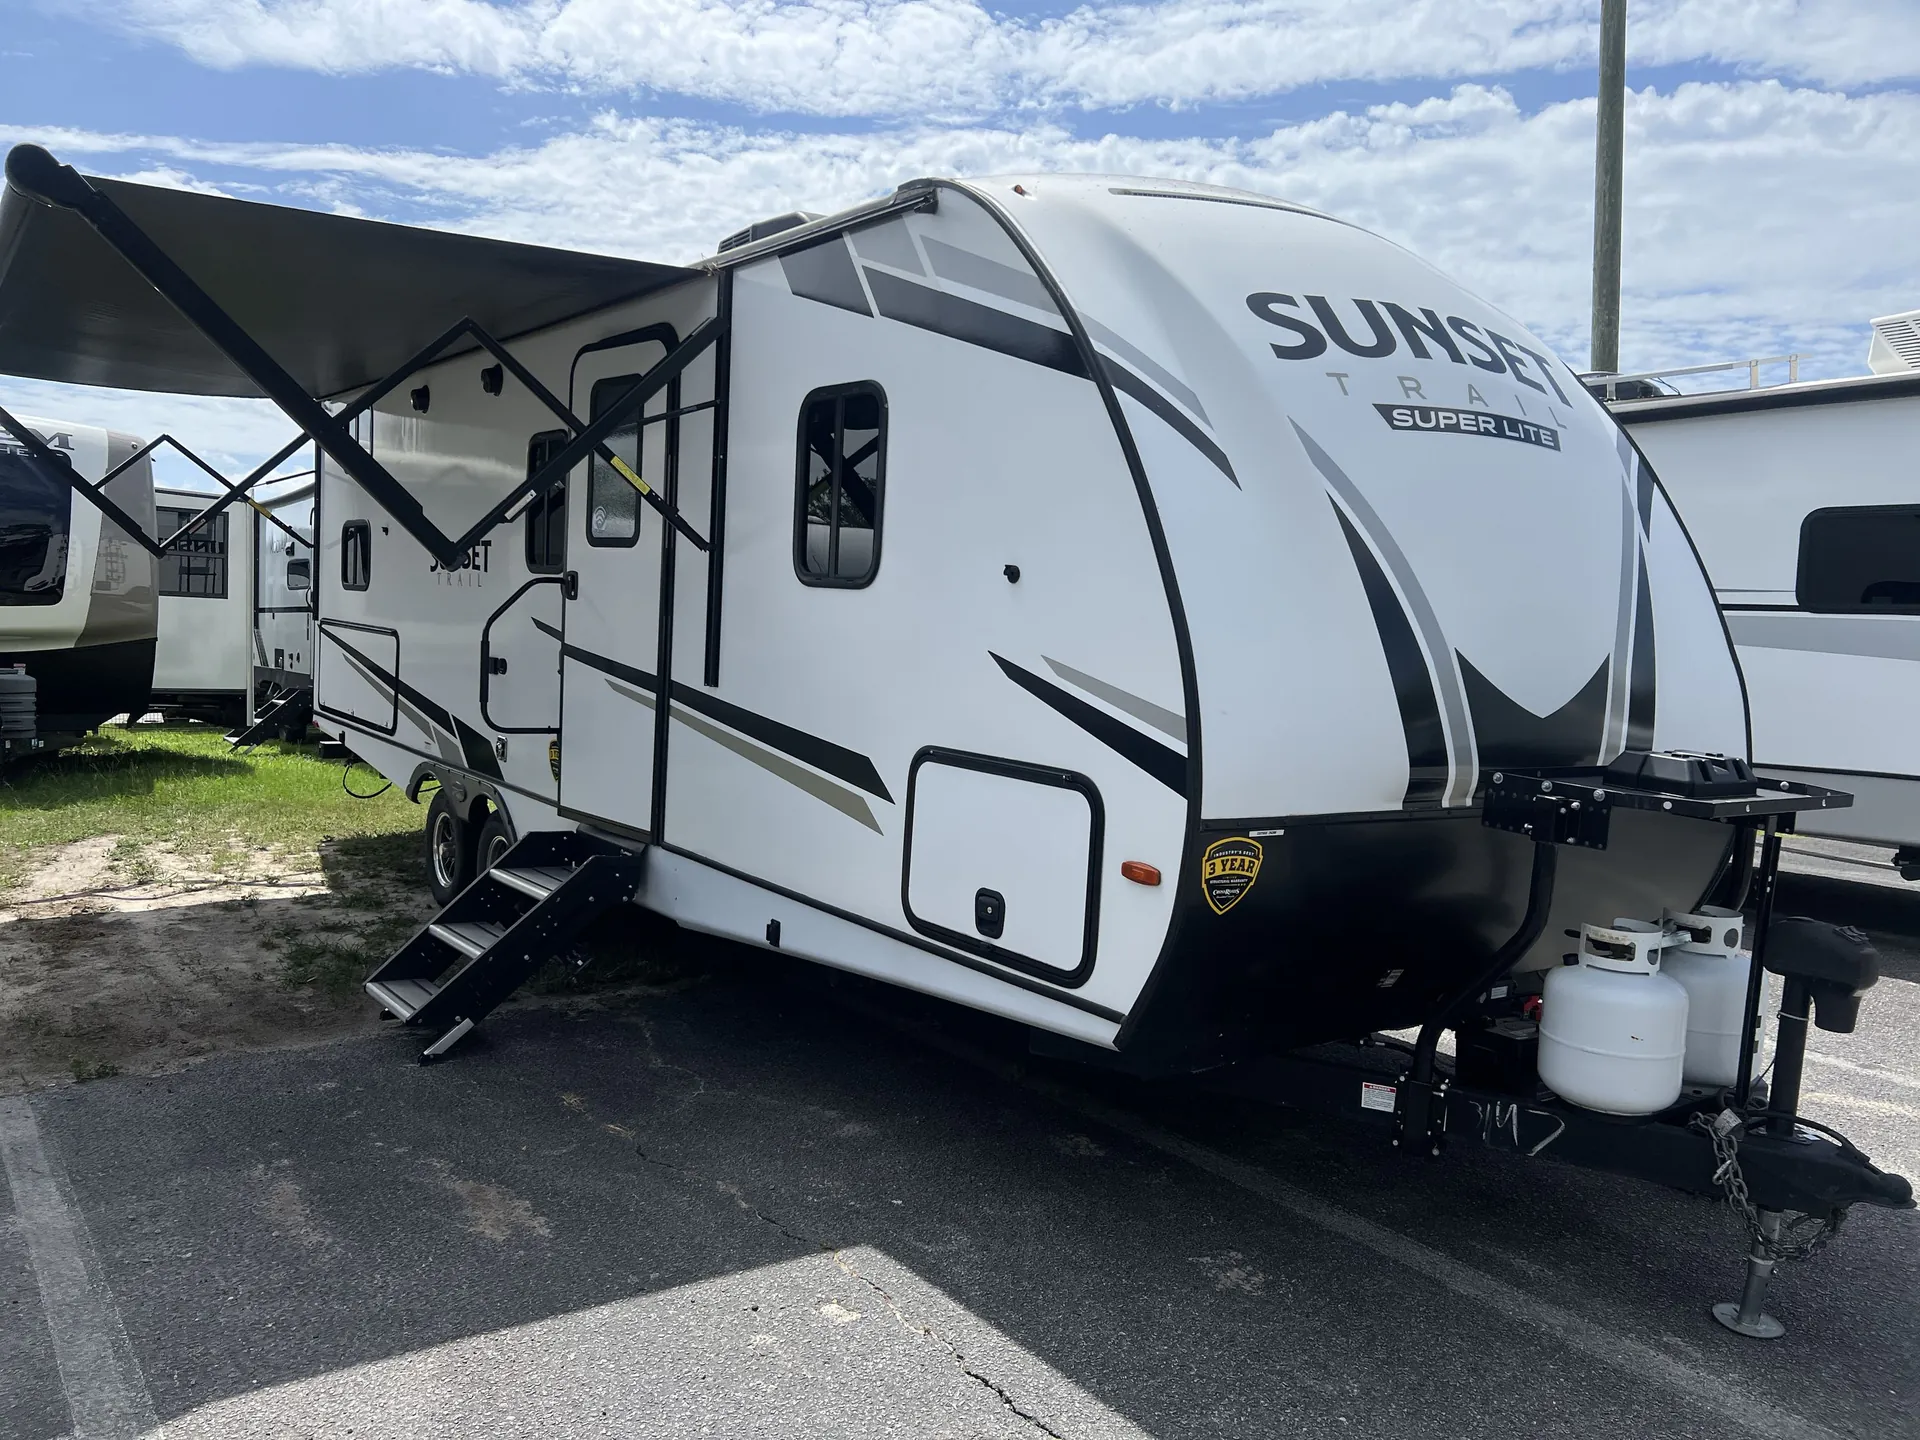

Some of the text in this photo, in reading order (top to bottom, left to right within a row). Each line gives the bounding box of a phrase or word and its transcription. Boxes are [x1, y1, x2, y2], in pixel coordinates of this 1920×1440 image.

[1246, 292, 1573, 410] SUNSET
[1326, 372, 1568, 430] TRAIL
[1392, 408, 1555, 447] SUPER LITE
[429, 540, 492, 573] SET
[437, 572, 482, 588] TRAIL
[1209, 858, 1255, 876] 3 YEAR
